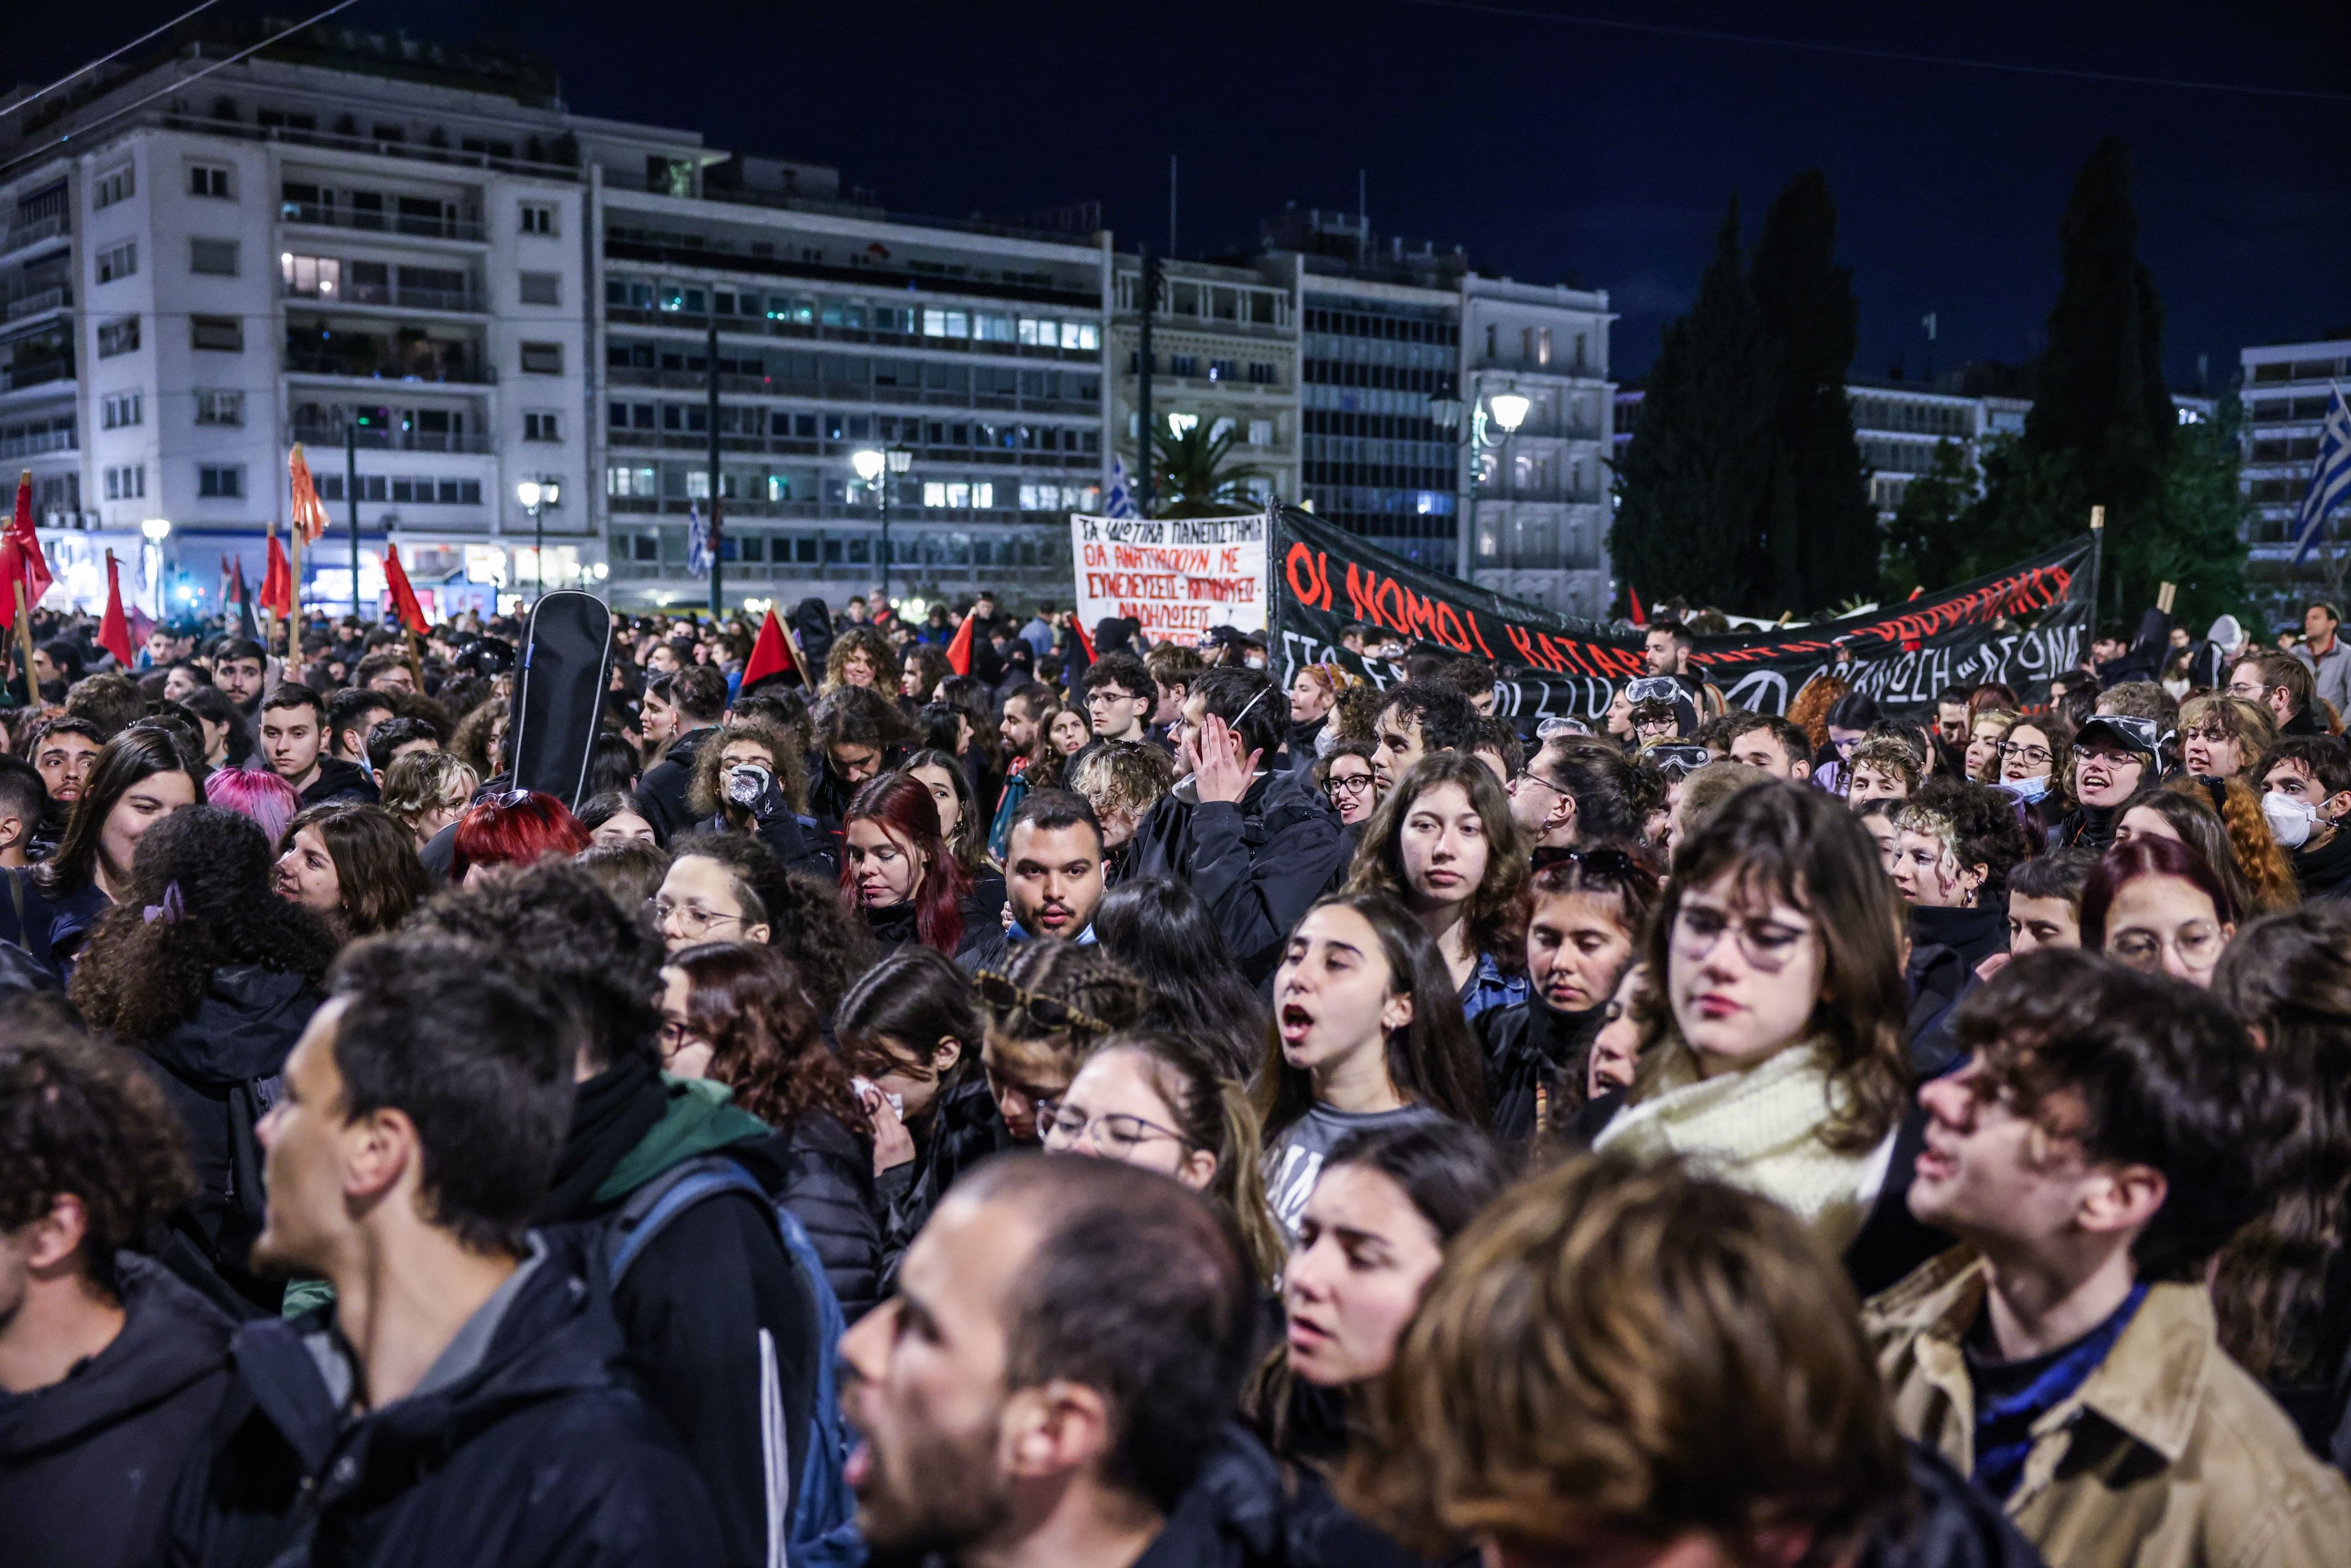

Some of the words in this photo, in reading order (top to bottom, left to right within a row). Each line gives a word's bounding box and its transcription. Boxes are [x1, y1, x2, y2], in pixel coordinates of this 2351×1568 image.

[1079, 518, 1099, 540] ΤΑ
[1084, 544, 1107, 566] ΘΑ
[1220, 547, 1240, 573] ΜΕ
[1286, 542, 1332, 612] ΟΙ
[1346, 561, 1495, 660] ΝΟΜΟΙ
